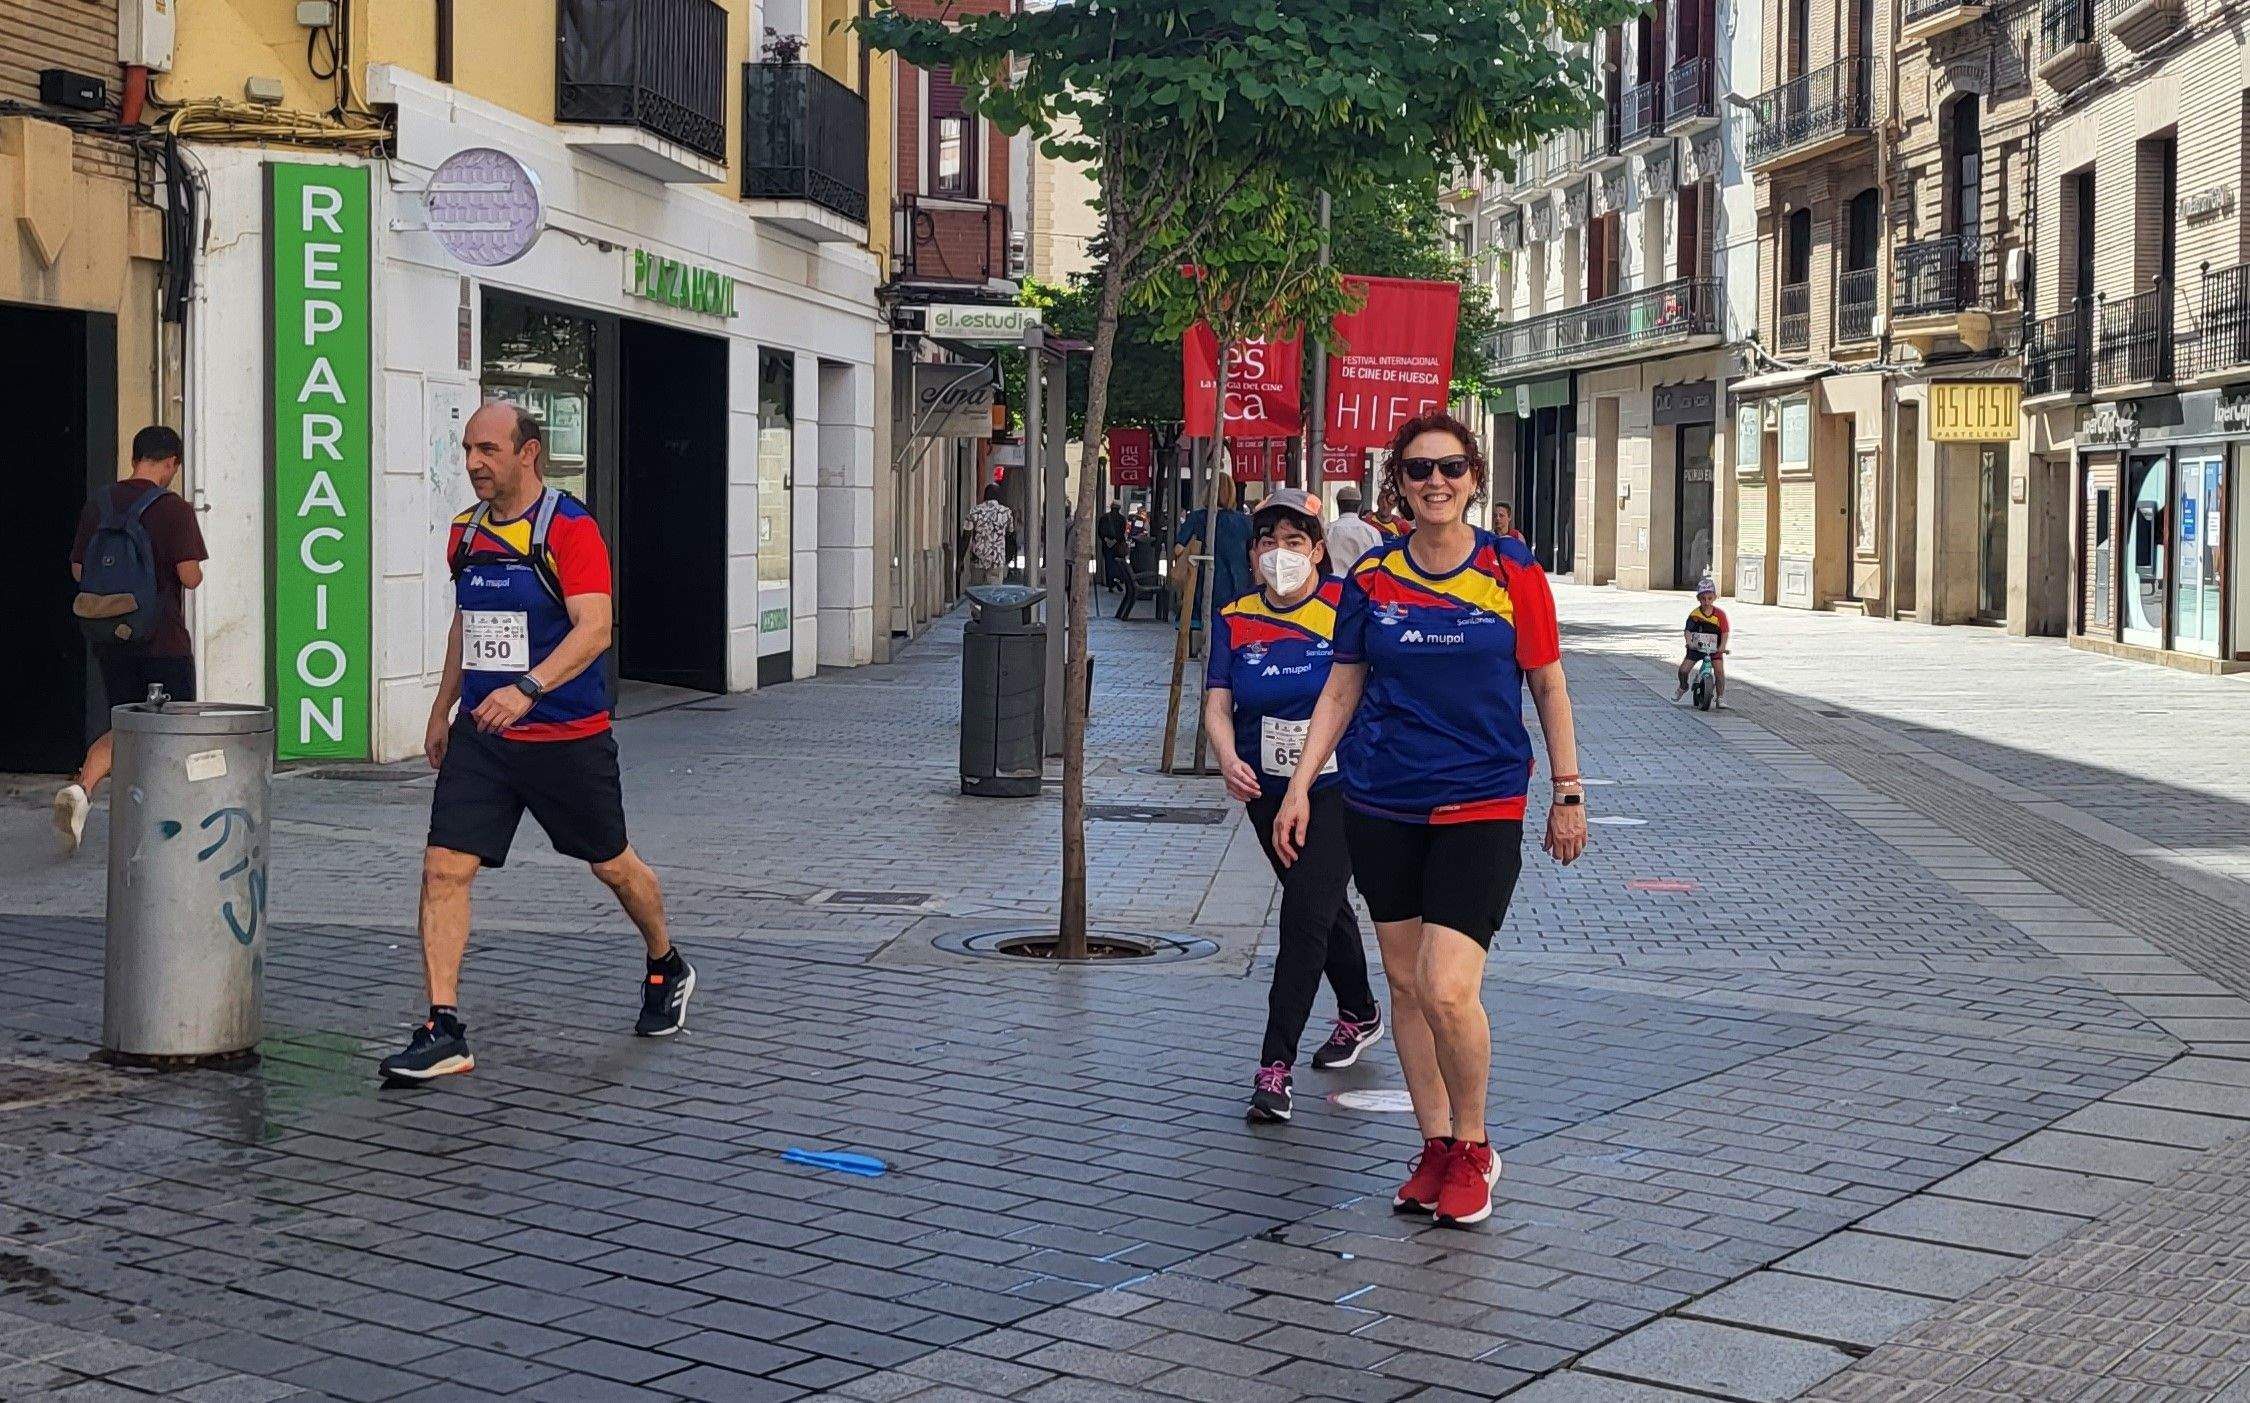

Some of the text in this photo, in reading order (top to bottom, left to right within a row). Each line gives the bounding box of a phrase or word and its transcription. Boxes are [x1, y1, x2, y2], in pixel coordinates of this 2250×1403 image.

[1342, 355, 1439, 366] FESTIVAL INTERNACIONAL
[1342, 366, 1439, 385] DE CINE DE HUESCA
[1936, 387, 2013, 427] ASCASO
[296, 184, 347, 744] REPARACION
[1426, 631, 1465, 645] mupol
[473, 640, 511, 659] 150
[1305, 648, 1334, 657] Santand
[1282, 662, 1312, 675] mupol
